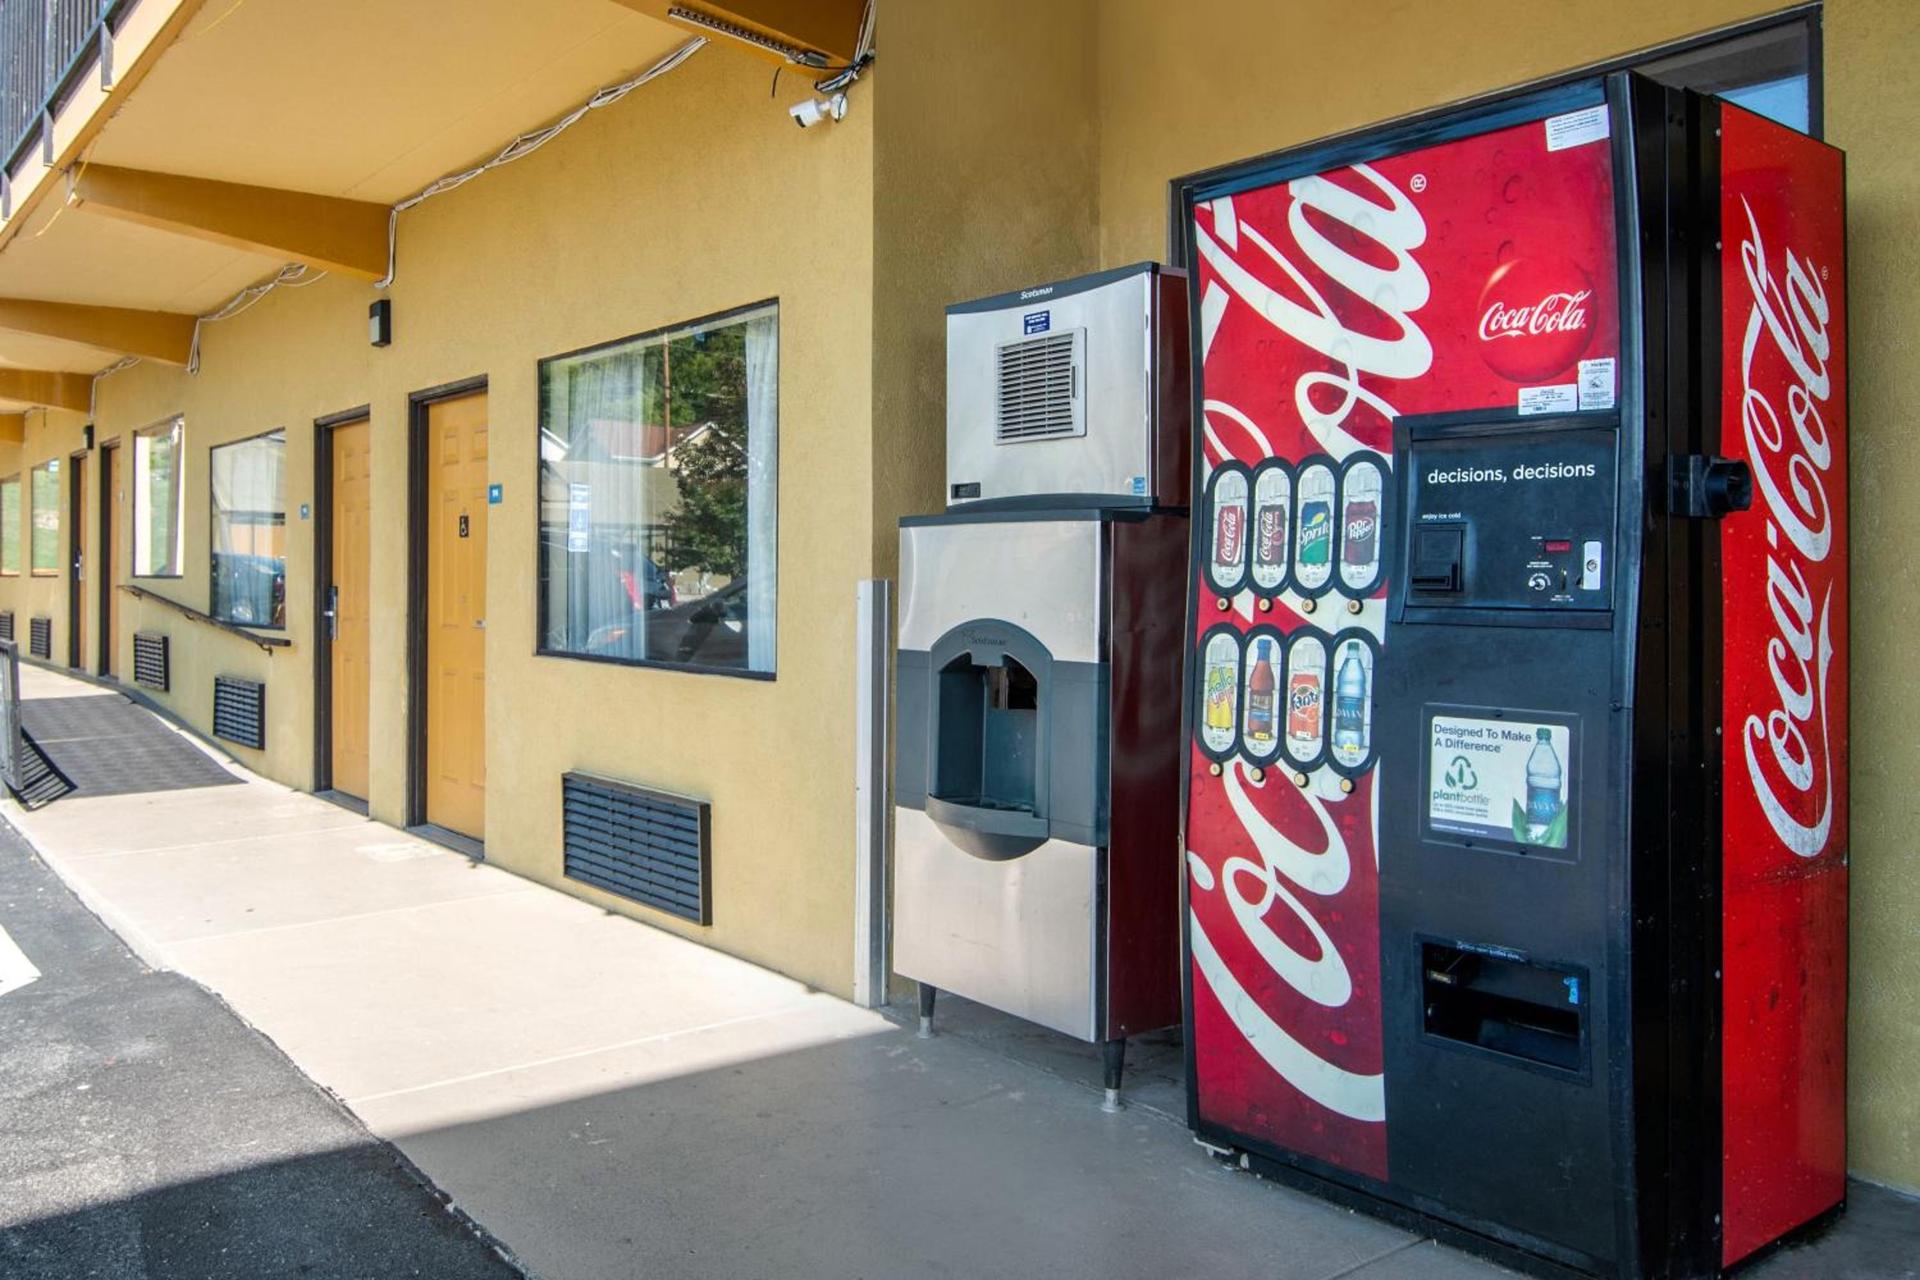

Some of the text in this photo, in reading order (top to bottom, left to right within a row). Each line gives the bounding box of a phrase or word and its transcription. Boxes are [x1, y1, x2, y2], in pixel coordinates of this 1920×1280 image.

[1479, 289, 1592, 341] Coca-Cola
[1427, 462, 1596, 484] decisions, decisions
[1422, 513, 1438, 521] enjoy
[1449, 511, 1462, 519] cold
[1740, 192, 1833, 858] Coca-Cola
[1434, 724, 1532, 742] Designed To Make
[1434, 737, 1501, 753] A Difference
